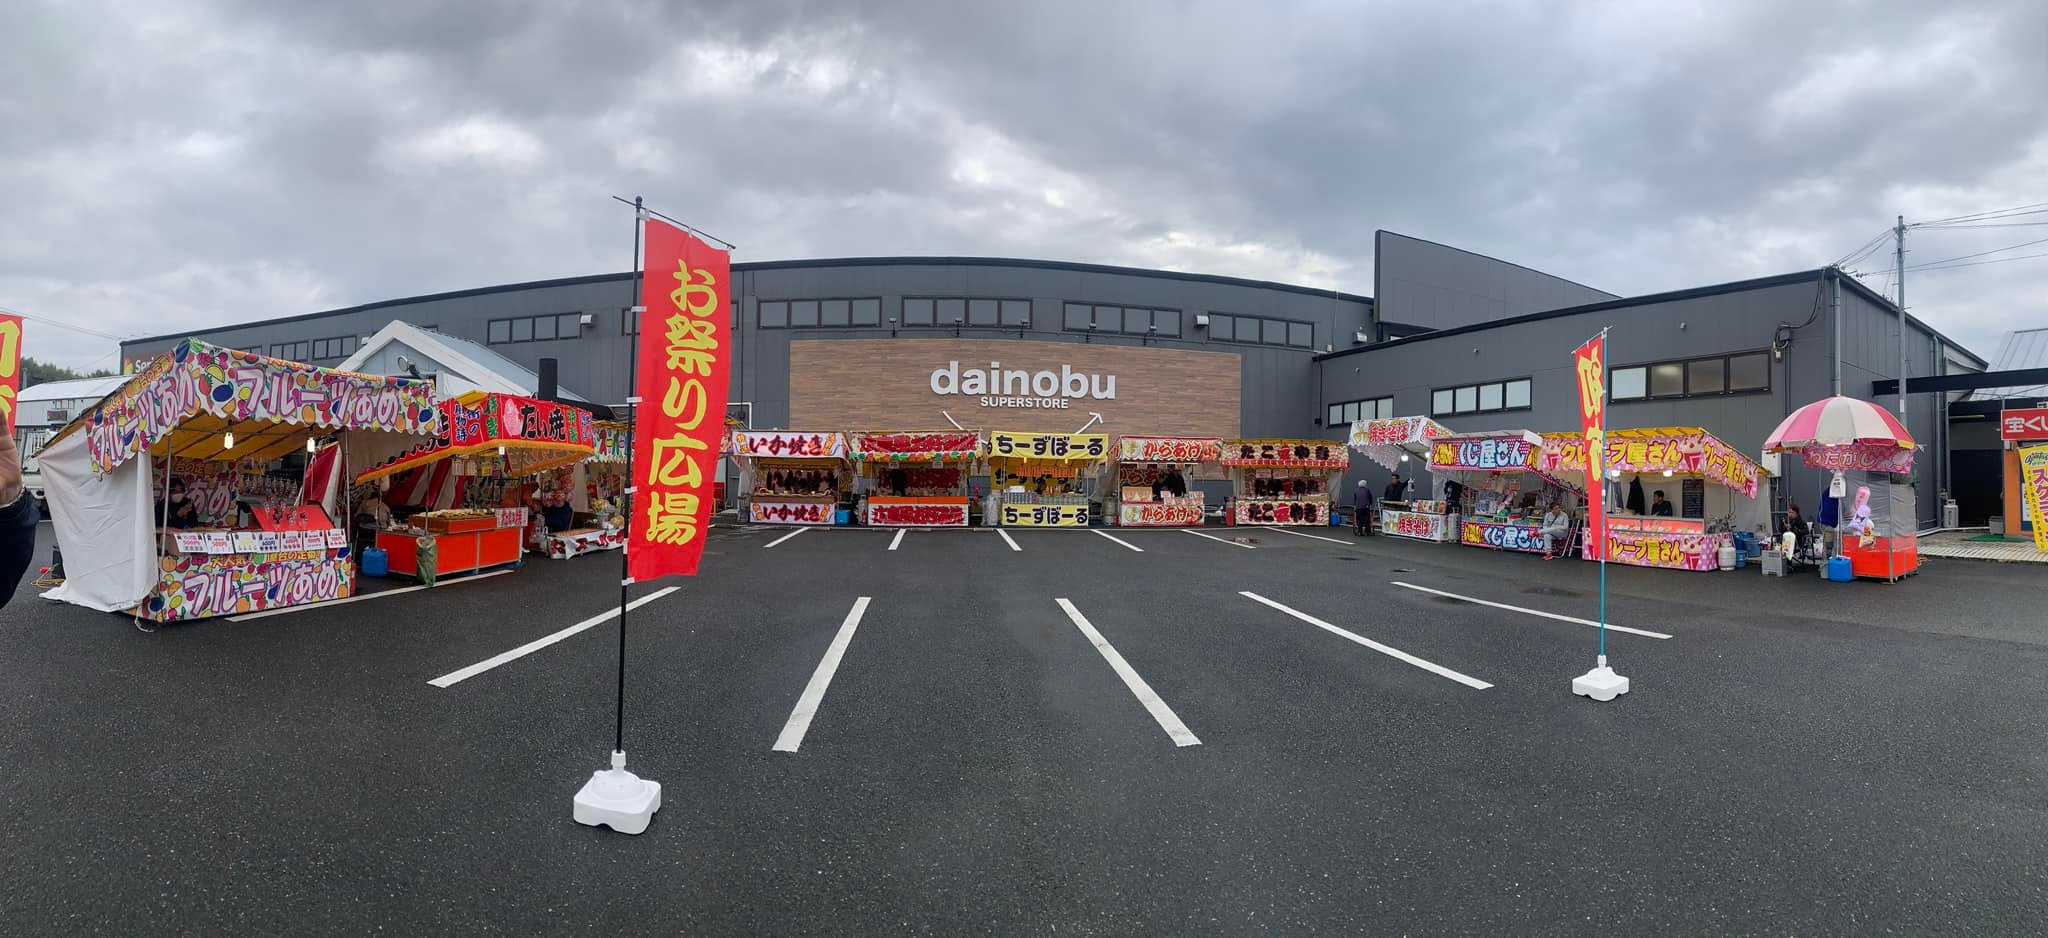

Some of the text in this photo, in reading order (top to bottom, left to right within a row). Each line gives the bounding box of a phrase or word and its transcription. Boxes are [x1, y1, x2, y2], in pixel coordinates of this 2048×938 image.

[930, 360, 1116, 399] dainobu
[236, 366, 399, 425] フルーツあめ
[645, 258, 718, 546] お祭り広場
[980, 396, 1069, 409] SUPERSTORE
[93, 361, 195, 470] フルーツあめ
[520, 404, 567, 441] たい焼
[748, 434, 823, 456] いか焼き
[995, 434, 1104, 456] ちーずぼーる
[1143, 439, 1202, 459] からあげ
[1459, 439, 1525, 468] くじ屋さん
[1561, 439, 1683, 468] クレプ屋さん
[763, 503, 821, 522] いか焼き
[1004, 506, 1088, 525] ちーずぼーる
[1141, 504, 1188, 523] からあげ
[1484, 526, 1544, 549] くじ屋さん
[1609, 534, 1685, 565] レープ屋さん
[183, 560, 339, 617] フルーツあめ
